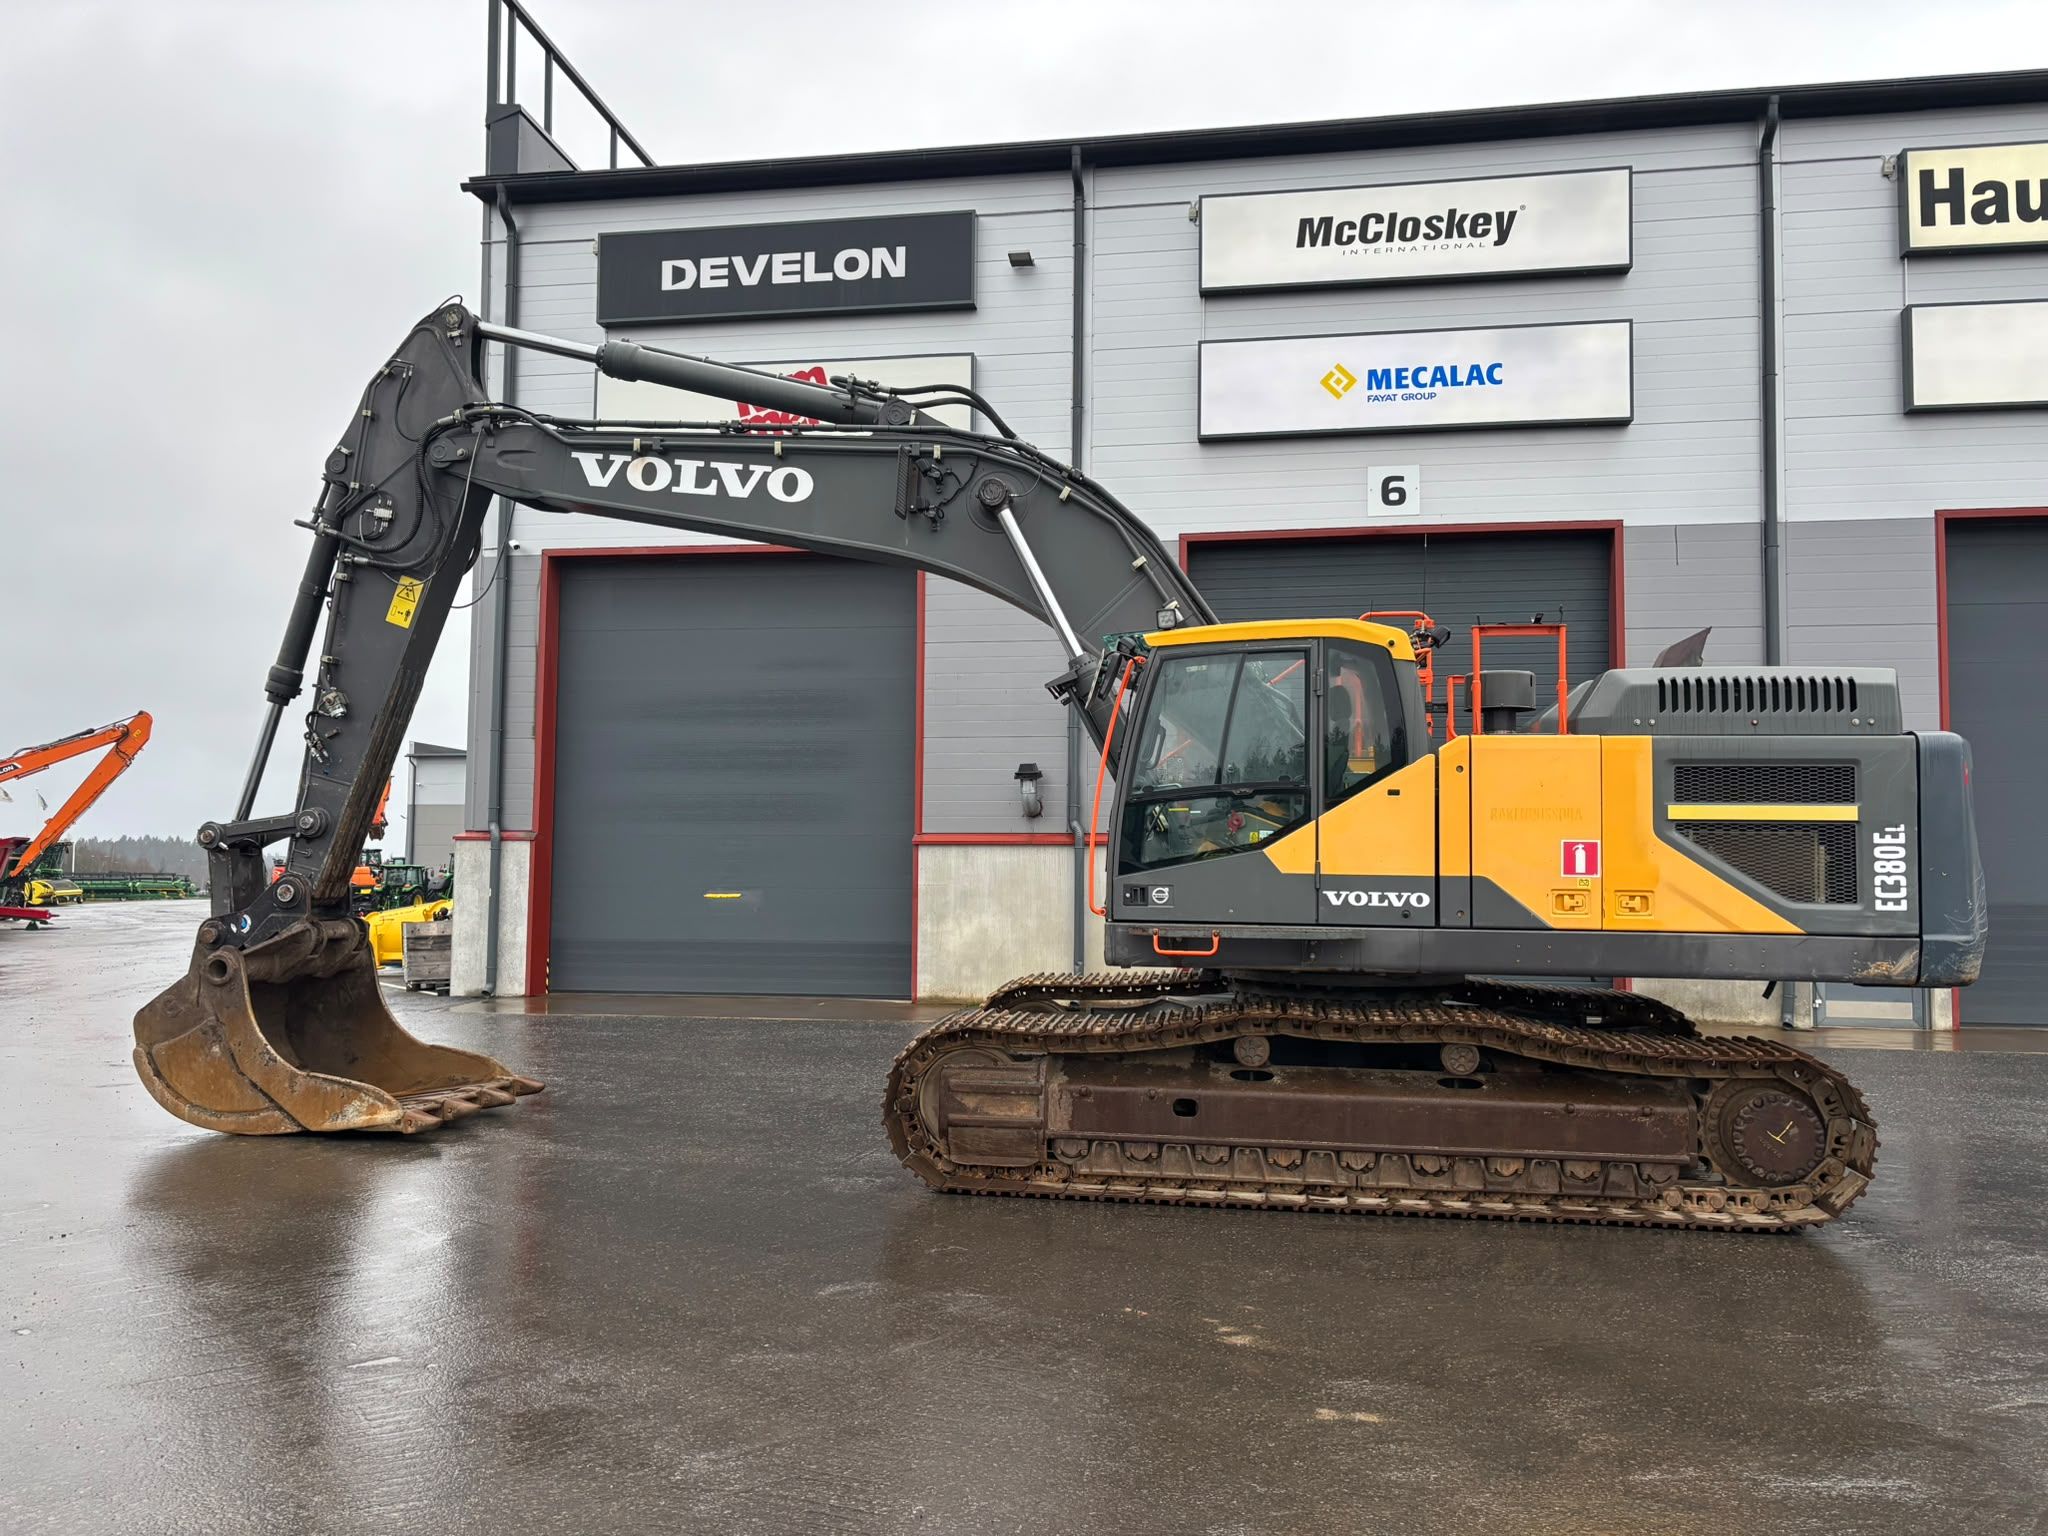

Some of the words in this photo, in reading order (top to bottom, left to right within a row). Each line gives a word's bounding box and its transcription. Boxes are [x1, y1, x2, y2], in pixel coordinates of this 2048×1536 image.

[1919, 167, 2048, 227] Hau
[1342, 242, 1486, 256] INTERNATIONAL
[661, 246, 906, 291] DEVELON
[1367, 363, 1503, 390] MECALAC
[1367, 393, 1397, 402] FAYAT
[1401, 392, 1437, 401] GROUP
[571, 452, 814, 503] VOLVO
[1381, 476, 1406, 506] 6
[1322, 891, 1430, 907] VOLVO
